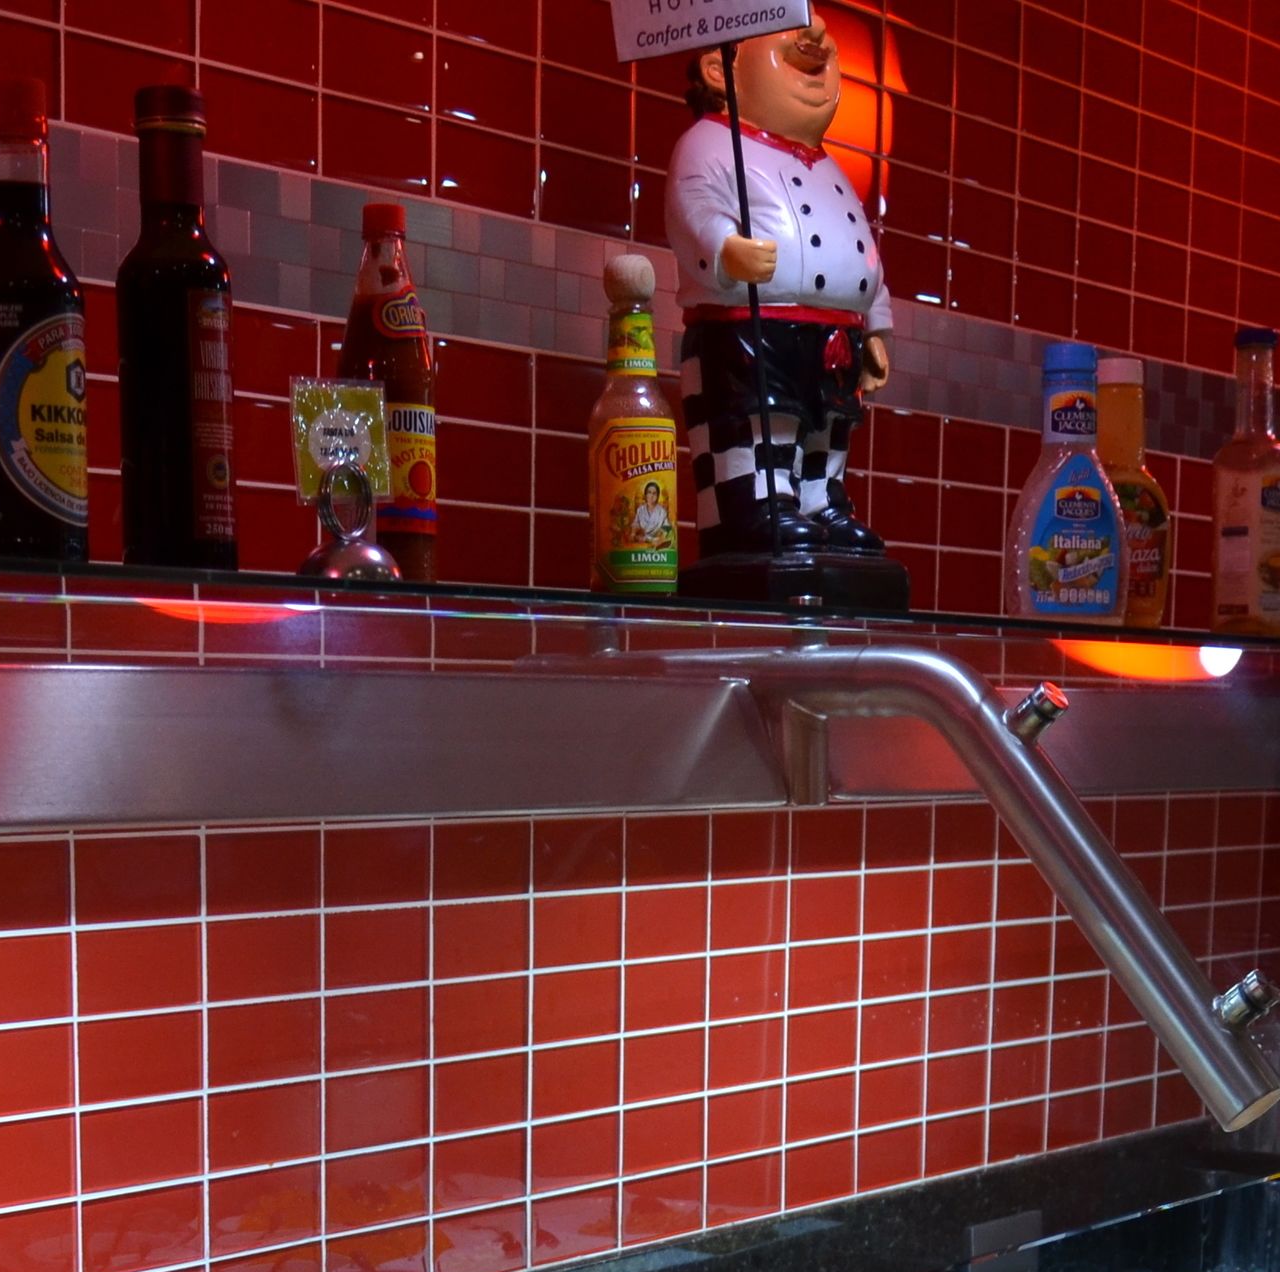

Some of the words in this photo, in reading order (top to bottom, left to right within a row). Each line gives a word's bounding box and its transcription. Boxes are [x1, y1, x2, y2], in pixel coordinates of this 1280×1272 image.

[649, 0, 713, 14] HO
[636, 24, 692, 47] Confort
[696, 19, 709, 35] &
[713, 6, 786, 32] Descanso
[38, 326, 65, 350] PARA
[35, 428, 73, 444] Salsa
[17, 456, 35, 478] BAJO
[391, 448, 416, 468] HOT
[604, 440, 675, 479] CHOLULA
[627, 464, 653, 478] SALSA
[1053, 533, 1102, 549] Italiana
